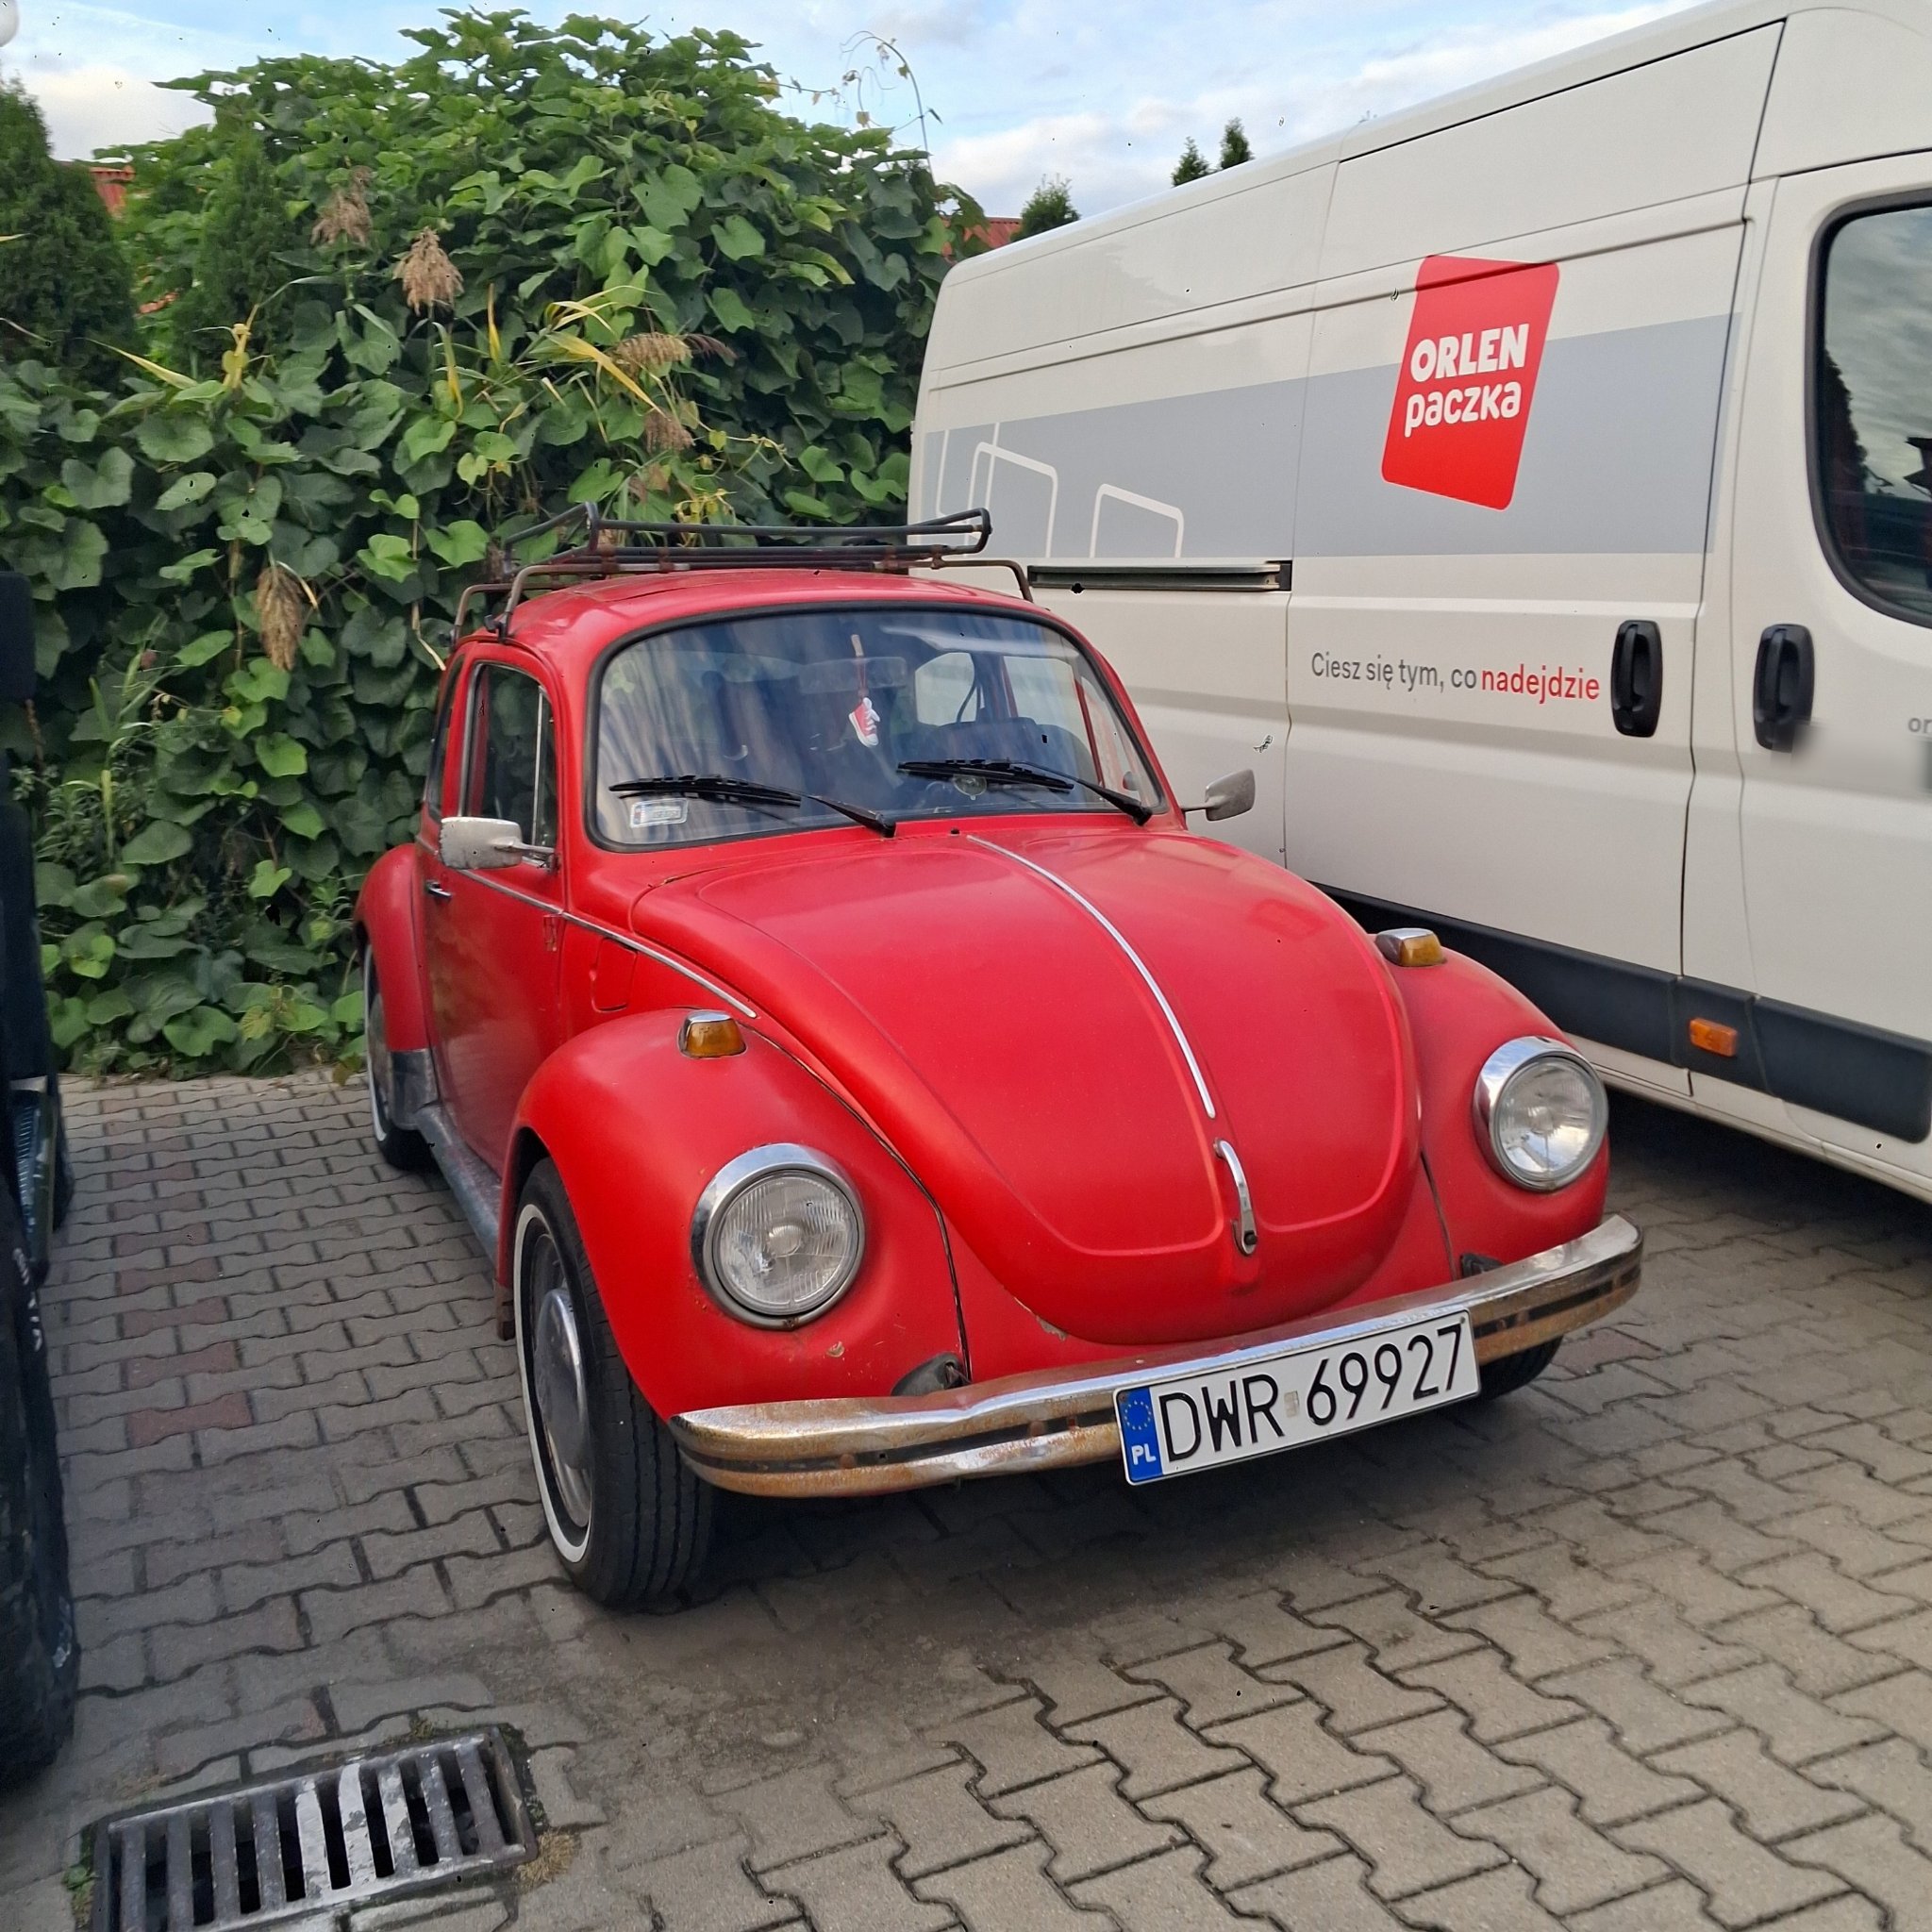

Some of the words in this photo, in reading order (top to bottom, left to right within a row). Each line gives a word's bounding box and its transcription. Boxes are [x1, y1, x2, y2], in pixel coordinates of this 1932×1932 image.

[1410, 323, 1529, 382] ORLEN
[1405, 381, 1521, 438] paczka
[1311, 651, 1360, 680] Ciesz
[1366, 654, 1393, 690] się
[1398, 658, 1444, 693] tym,
[1451, 669, 1477, 689] co
[1481, 663, 1600, 704] nadejdzie
[1158, 1373, 1285, 1462] DWR
[1306, 1323, 1462, 1425] 69927
[1132, 1444, 1157, 1465] PL
